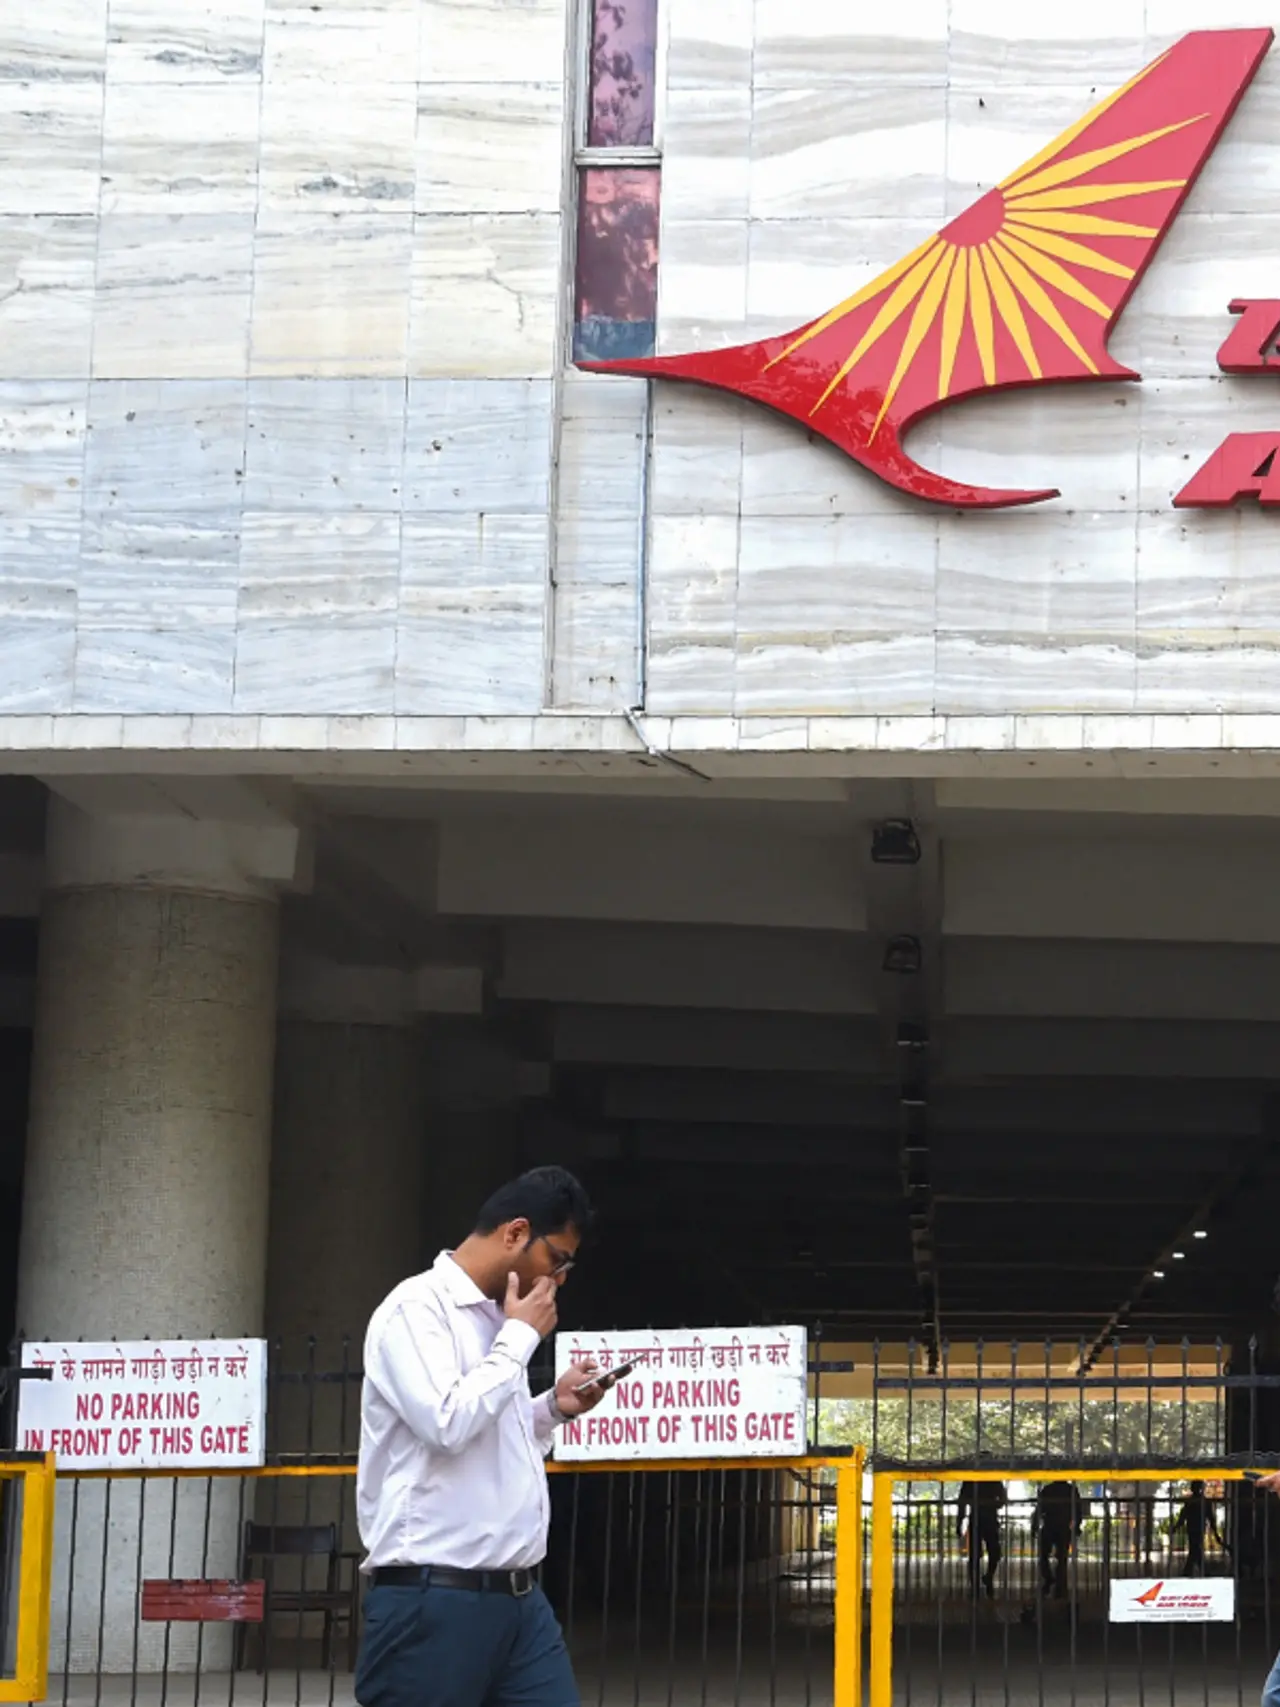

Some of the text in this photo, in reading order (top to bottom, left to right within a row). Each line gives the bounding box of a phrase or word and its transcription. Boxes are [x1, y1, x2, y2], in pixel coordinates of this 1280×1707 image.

[60, 1349, 75, 1380] के
[82, 1348, 125, 1381] सामने
[131, 1348, 166, 1383] गाड़ी
[171, 1347, 203, 1383] खड़ी
[208, 1356, 220, 1377] न
[225, 1345, 248, 1379] करें
[598, 1338, 613, 1369] के
[668, 1336, 704, 1373] गाड़ी
[748, 1344, 761, 1365] न
[765, 1332, 791, 1366] करें
[77, 1391, 199, 1421] NO PARKING
[617, 1378, 740, 1408] NO PARKING
[24, 1425, 248, 1455] IN FRONT OF THIS GATE
[563, 1412, 794, 1445] IN FRONT OF THIS GATE
